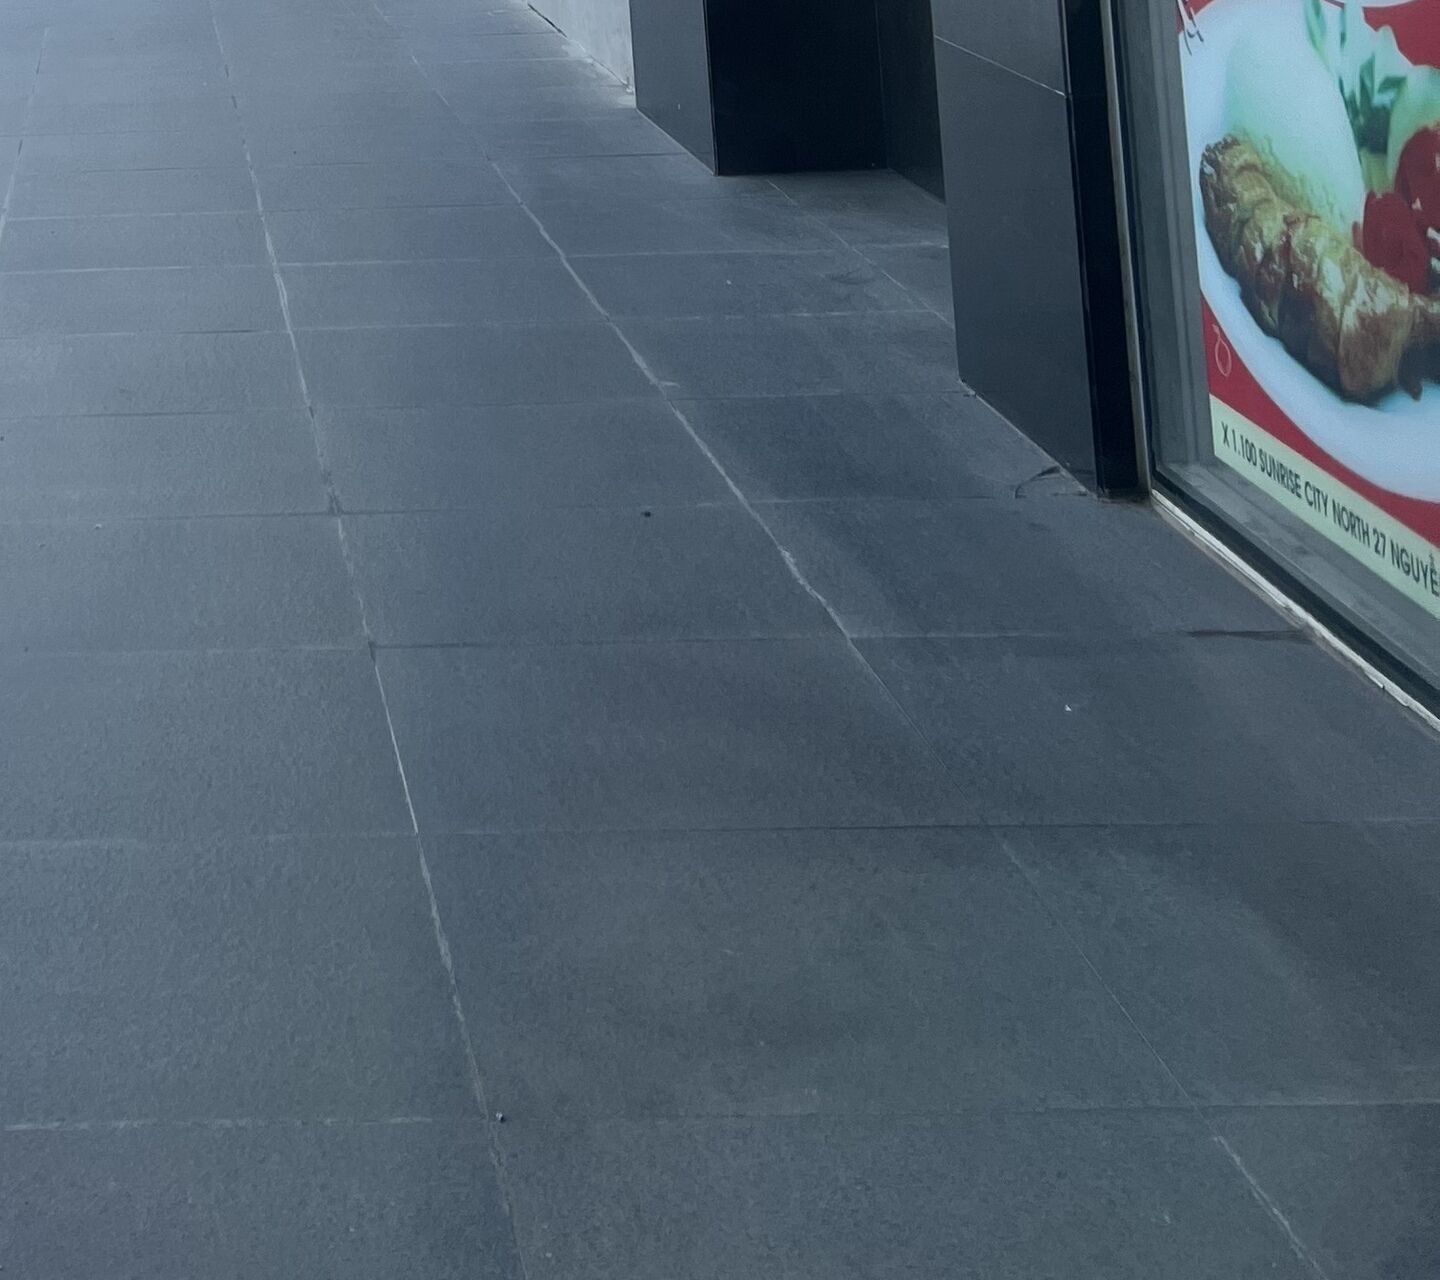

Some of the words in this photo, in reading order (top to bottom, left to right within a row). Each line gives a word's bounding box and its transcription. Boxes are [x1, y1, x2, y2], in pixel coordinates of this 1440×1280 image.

[1259, 448, 1302, 500] SUNRISE
[1304, 480, 1329, 518] CITY
[1332, 498, 1370, 549] NORTH
[1373, 527, 1386, 559] 27
